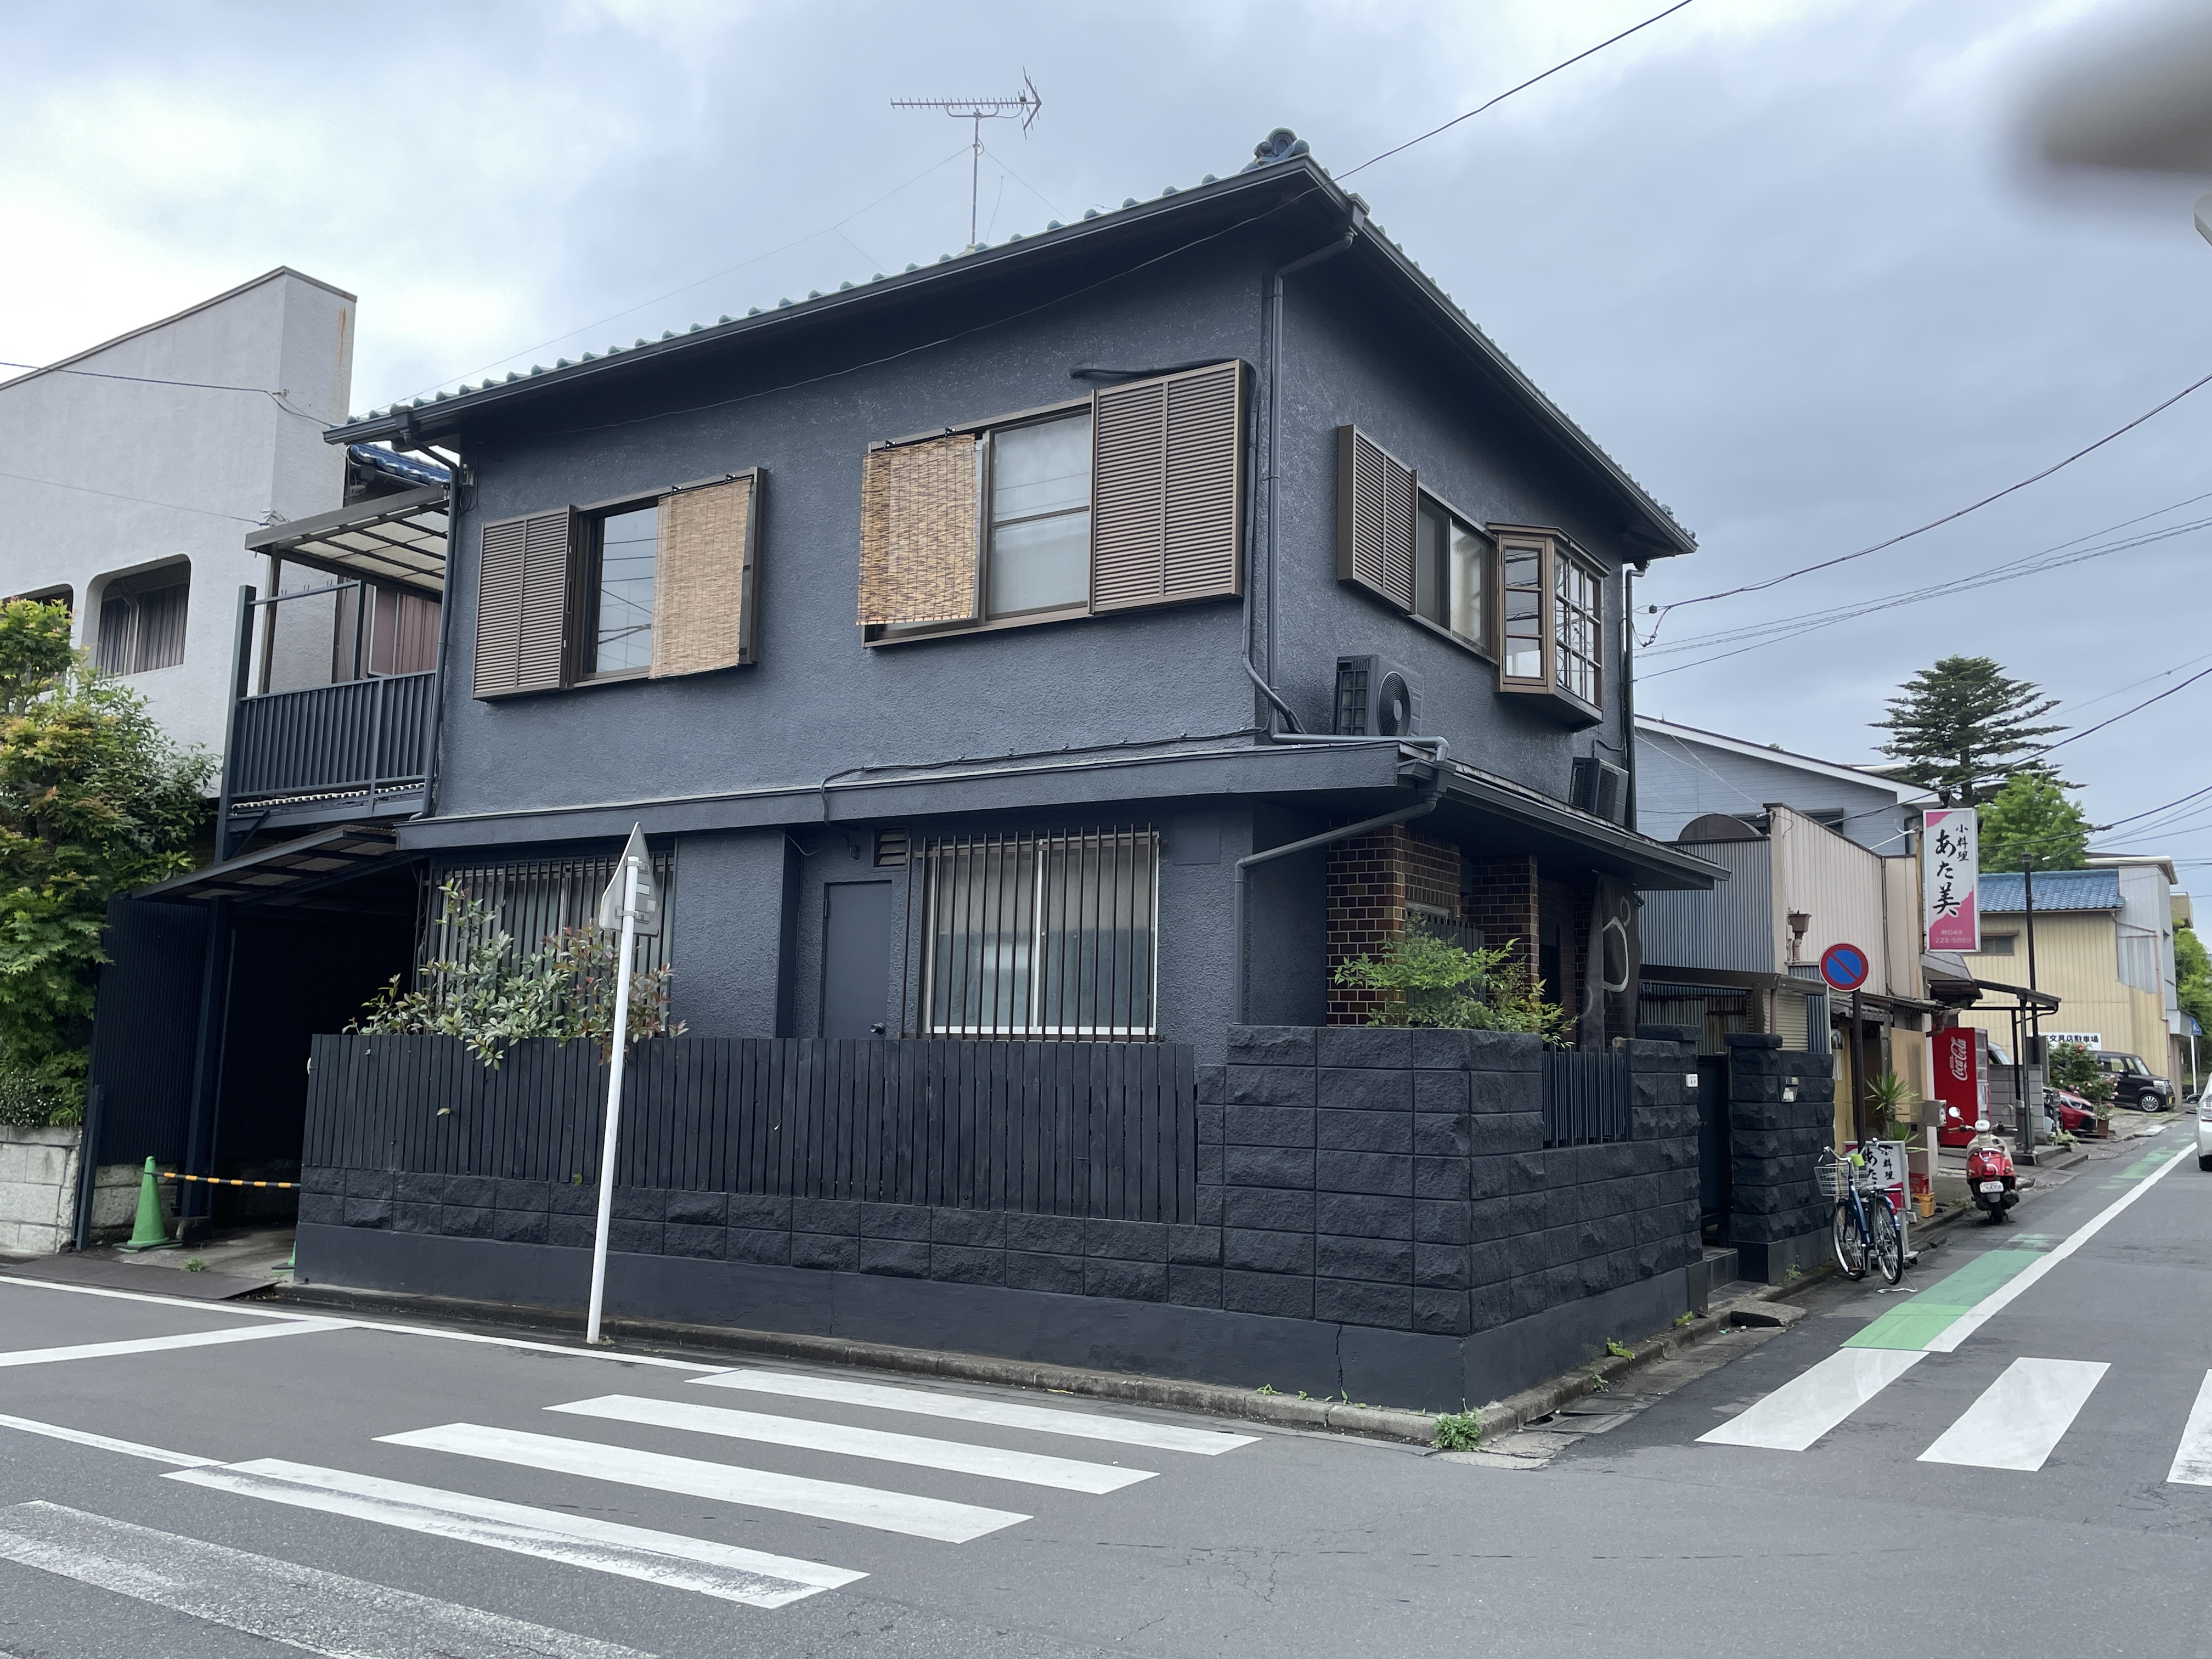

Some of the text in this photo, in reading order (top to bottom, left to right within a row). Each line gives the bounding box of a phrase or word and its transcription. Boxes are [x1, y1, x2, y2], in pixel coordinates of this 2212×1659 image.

[1955, 823, 1970, 862] 小料理
[1932, 828, 1961, 916] あた美
[1866, 1147, 1878, 1185] あた
